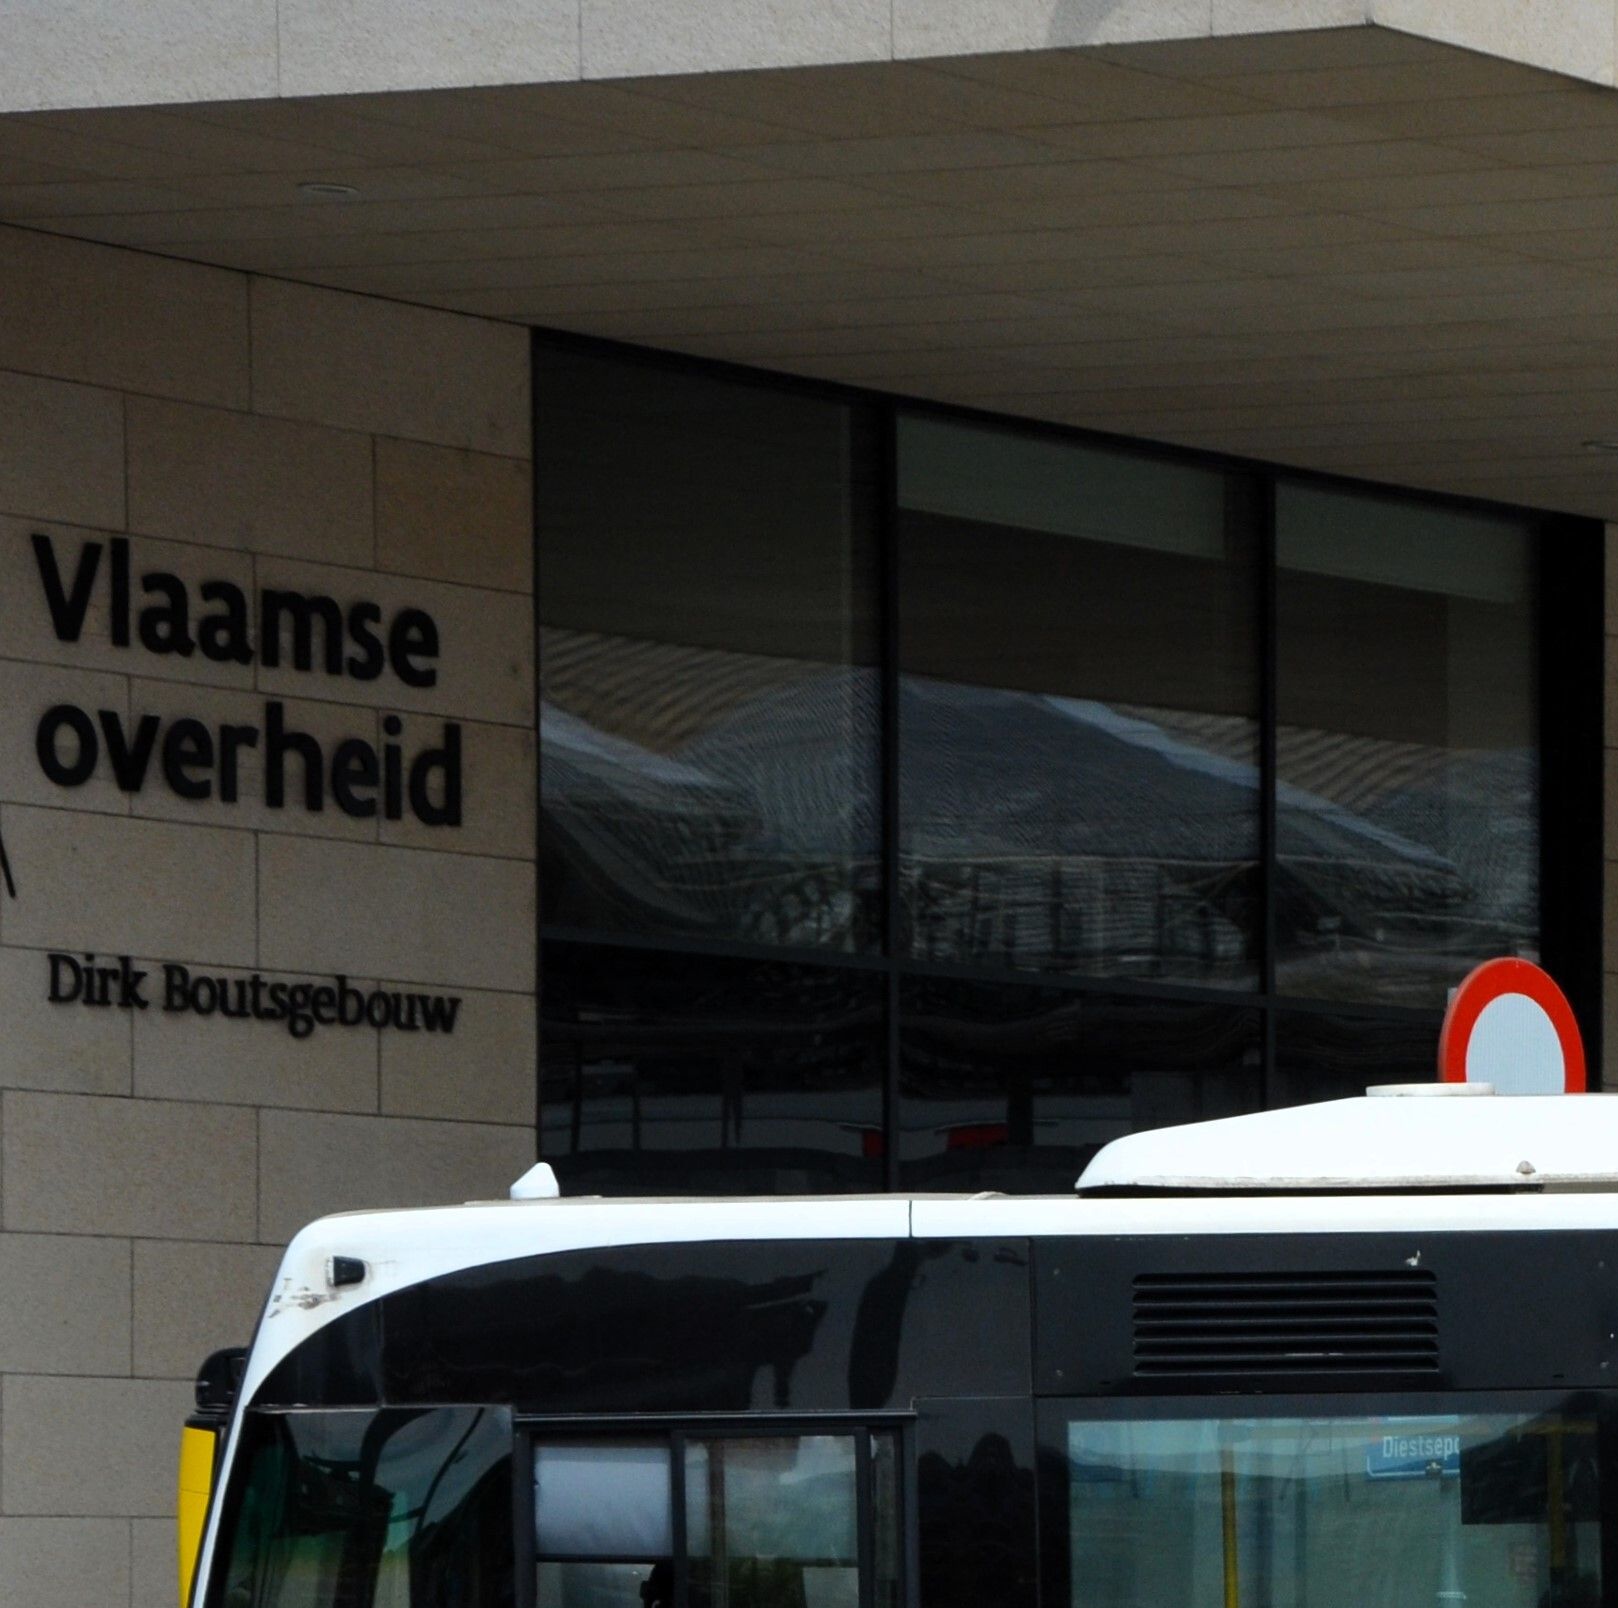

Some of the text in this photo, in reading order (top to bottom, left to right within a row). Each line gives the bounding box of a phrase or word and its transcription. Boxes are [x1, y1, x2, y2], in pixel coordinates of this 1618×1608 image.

[31, 534, 439, 688] Vlaamse
[36, 702, 462, 827] overheid
[47, 953, 462, 1039] Dirk Boutsgebouw
